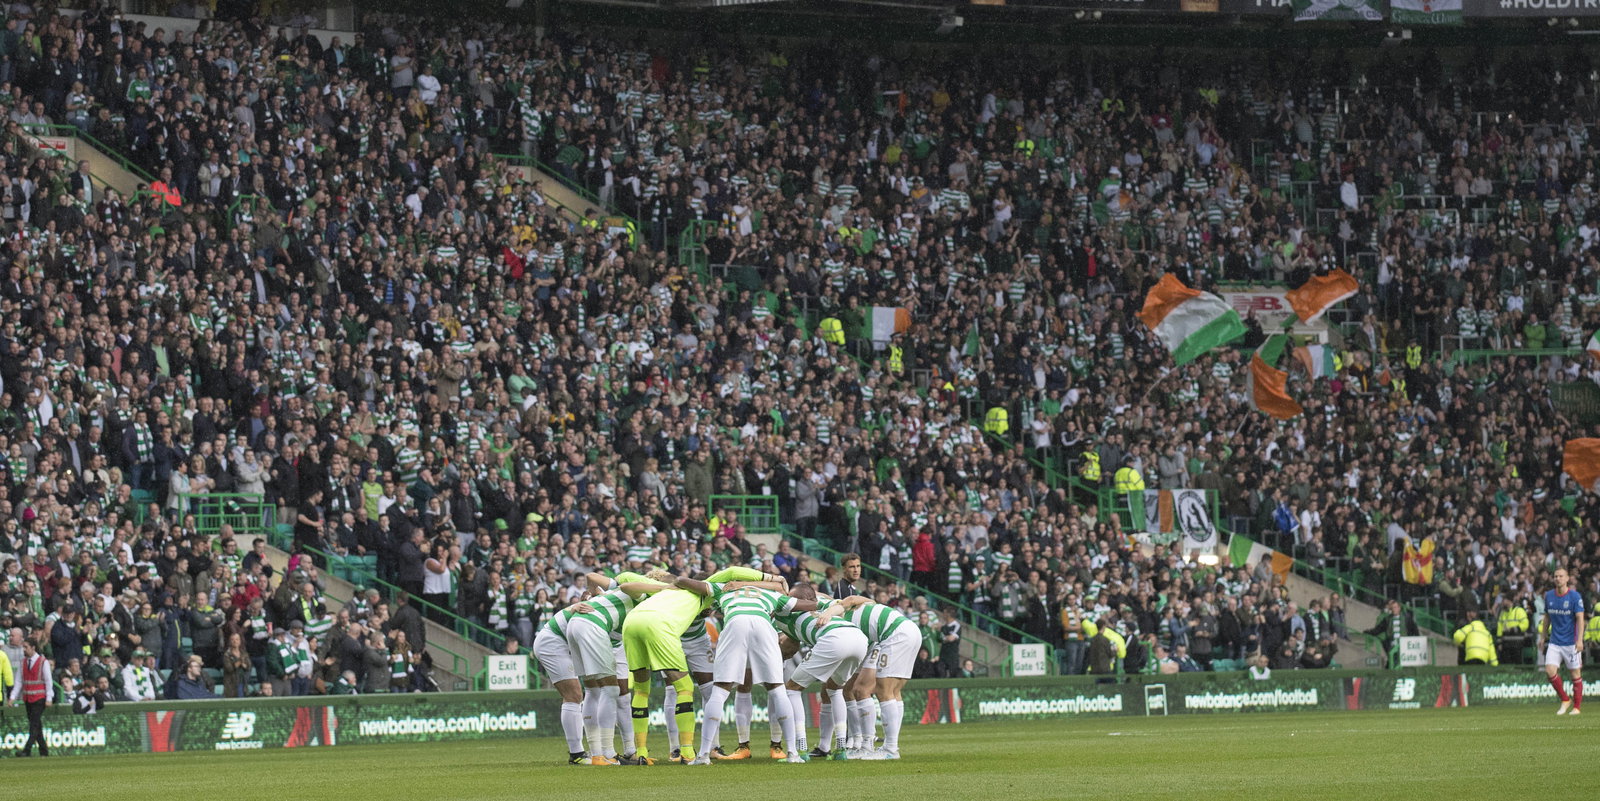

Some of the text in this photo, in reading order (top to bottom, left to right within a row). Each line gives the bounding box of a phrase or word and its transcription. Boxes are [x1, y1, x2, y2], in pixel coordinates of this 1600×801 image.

[1500, 0, 1600, 9] #HOLDTR
[1407, 640, 1420, 650] Exit
[1021, 649, 1037, 658] Exit
[1401, 652, 1427, 662] Gate 14
[498, 660, 517, 671] Exit
[1015, 661, 1045, 671] Gate 12
[490, 674, 526, 685] Gate 11
[1185, 687, 1318, 707] newbalance.com/football
[979, 694, 1122, 715] newbalance.com/football
[359, 711, 536, 736] newbalance.com/football
